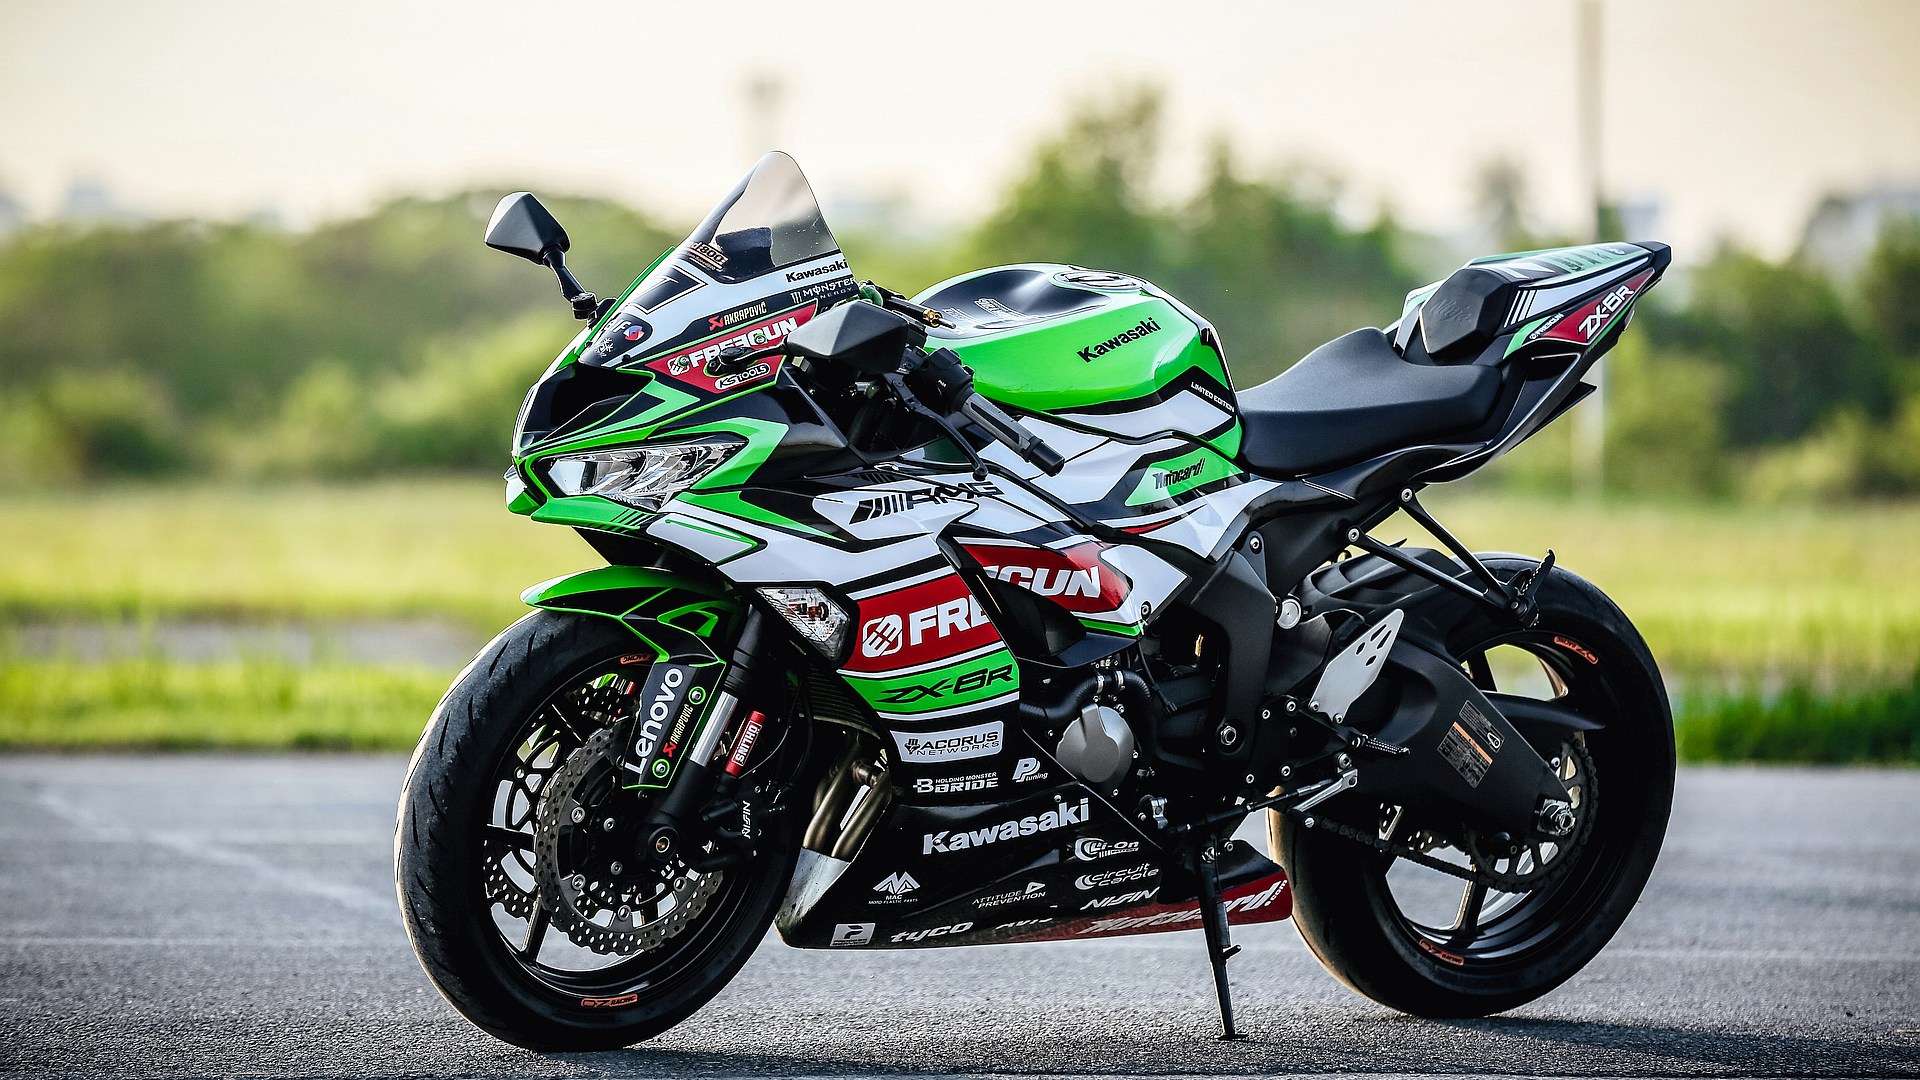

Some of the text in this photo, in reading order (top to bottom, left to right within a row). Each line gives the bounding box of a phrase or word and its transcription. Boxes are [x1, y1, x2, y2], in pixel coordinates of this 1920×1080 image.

[786, 259, 848, 282] Kawasaki
[1578, 284, 1635, 341] ZX-6R
[1077, 317, 1162, 363] Kawasaki
[1191, 381, 1235, 412] LIMITED EDITION
[907, 480, 1005, 510] AMG
[874, 663, 1014, 703] ZX-6R
[624, 667, 684, 775] Lenovo
[916, 741, 999, 756] NETWORKS
[922, 731, 998, 750] ACORUS
[935, 772, 997, 783] HOLDING MONSTER
[935, 778, 998, 793] BRIDE
[1025, 772, 1048, 782] tuning
[922, 798, 1090, 856] Kawasaki
[1091, 862, 1150, 881] circuit
[1098, 868, 1159, 886] carole
[972, 889, 1022, 906] ATTITUDE
[978, 891, 1046, 909] PREVENTION
[890, 921, 974, 943] tyco
